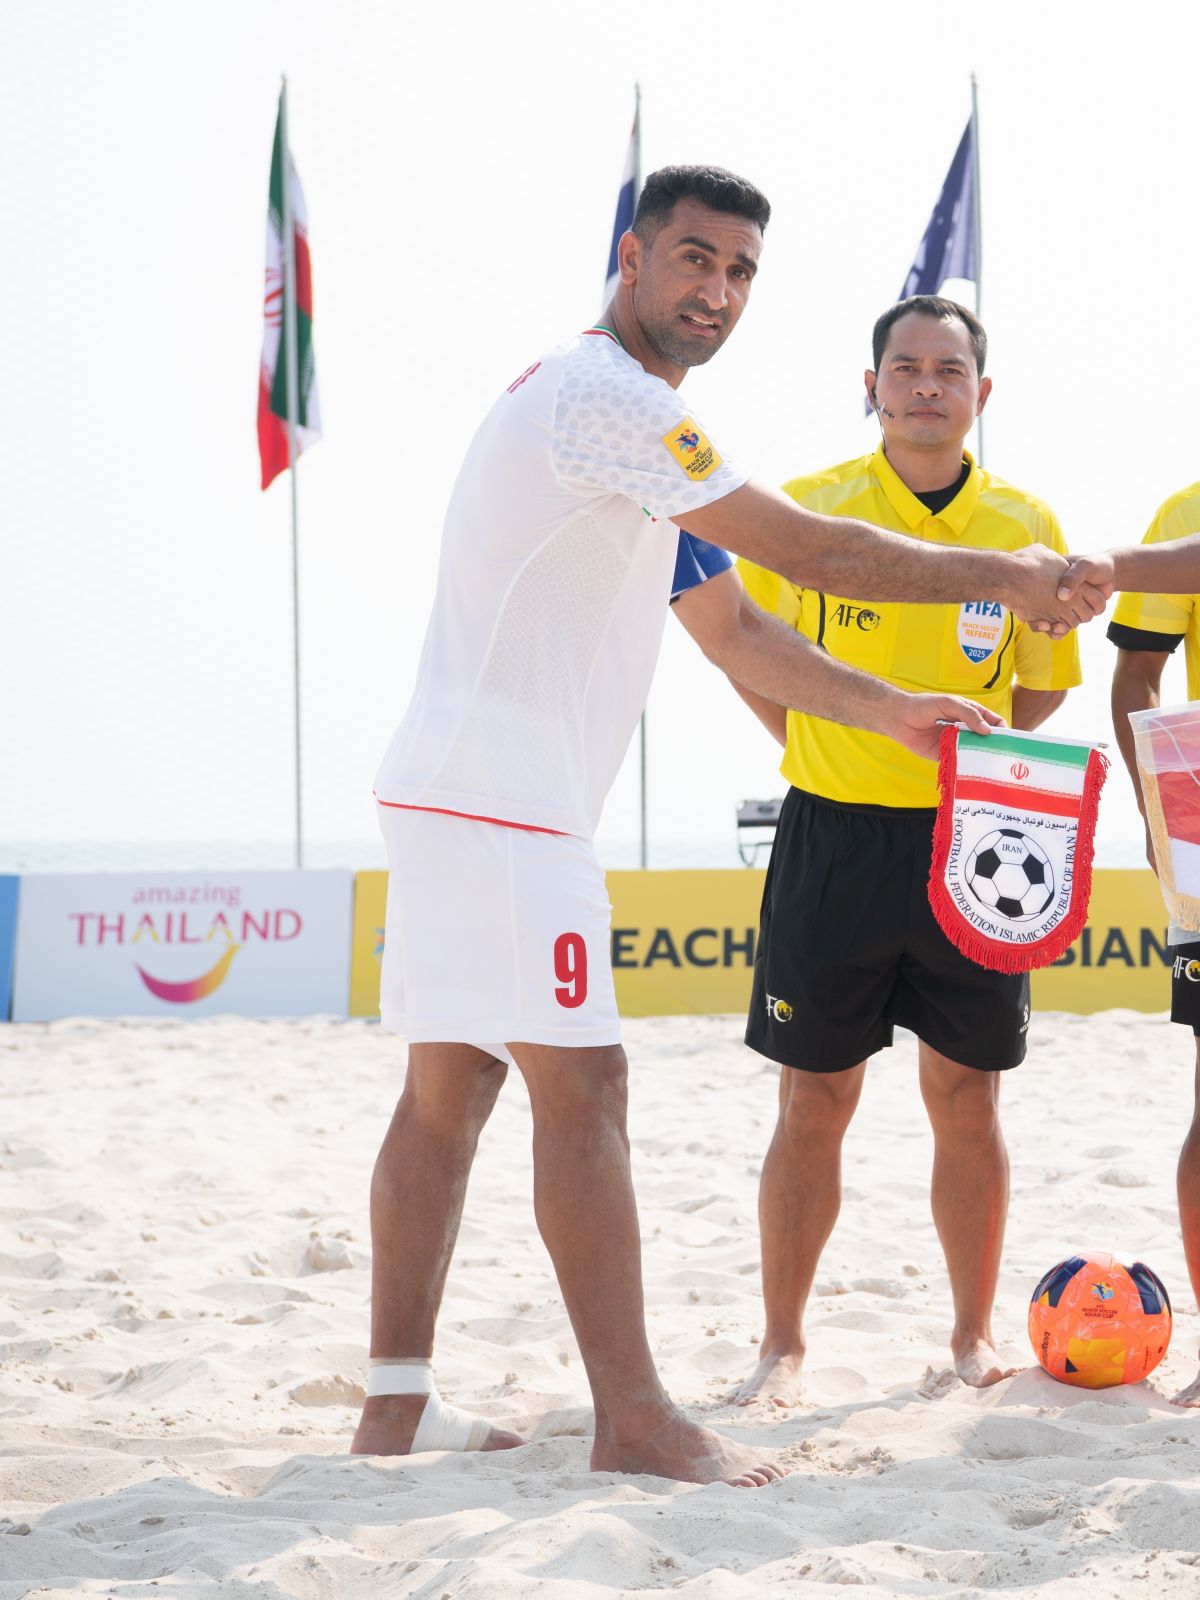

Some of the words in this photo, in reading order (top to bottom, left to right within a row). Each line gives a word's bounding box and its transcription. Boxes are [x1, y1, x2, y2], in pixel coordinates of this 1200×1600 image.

[691, 460, 706, 474] ASIAN
[829, 604, 881, 632] AFC
[965, 601, 1002, 618] FIFA
[965, 629, 995, 640] REFEREE
[969, 649, 986, 658] 2025
[955, 806, 970, 815] ایران
[1023, 816, 1044, 828] فوتبال
[949, 818, 963, 879] FOOTBALL
[1002, 844, 1023, 854] IRAN
[1065, 836, 1076, 864] IRAN
[1063, 867, 1074, 882] OF
[132, 881, 241, 907] amazing
[950, 881, 999, 935] FEDERATION
[1040, 884, 1072, 933] REPUBLIC
[68, 908, 303, 946] THAILAND
[999, 928, 1042, 943] ISLAMIC
[611, 928, 755, 968] EACH
[553, 932, 588, 1008] 9
